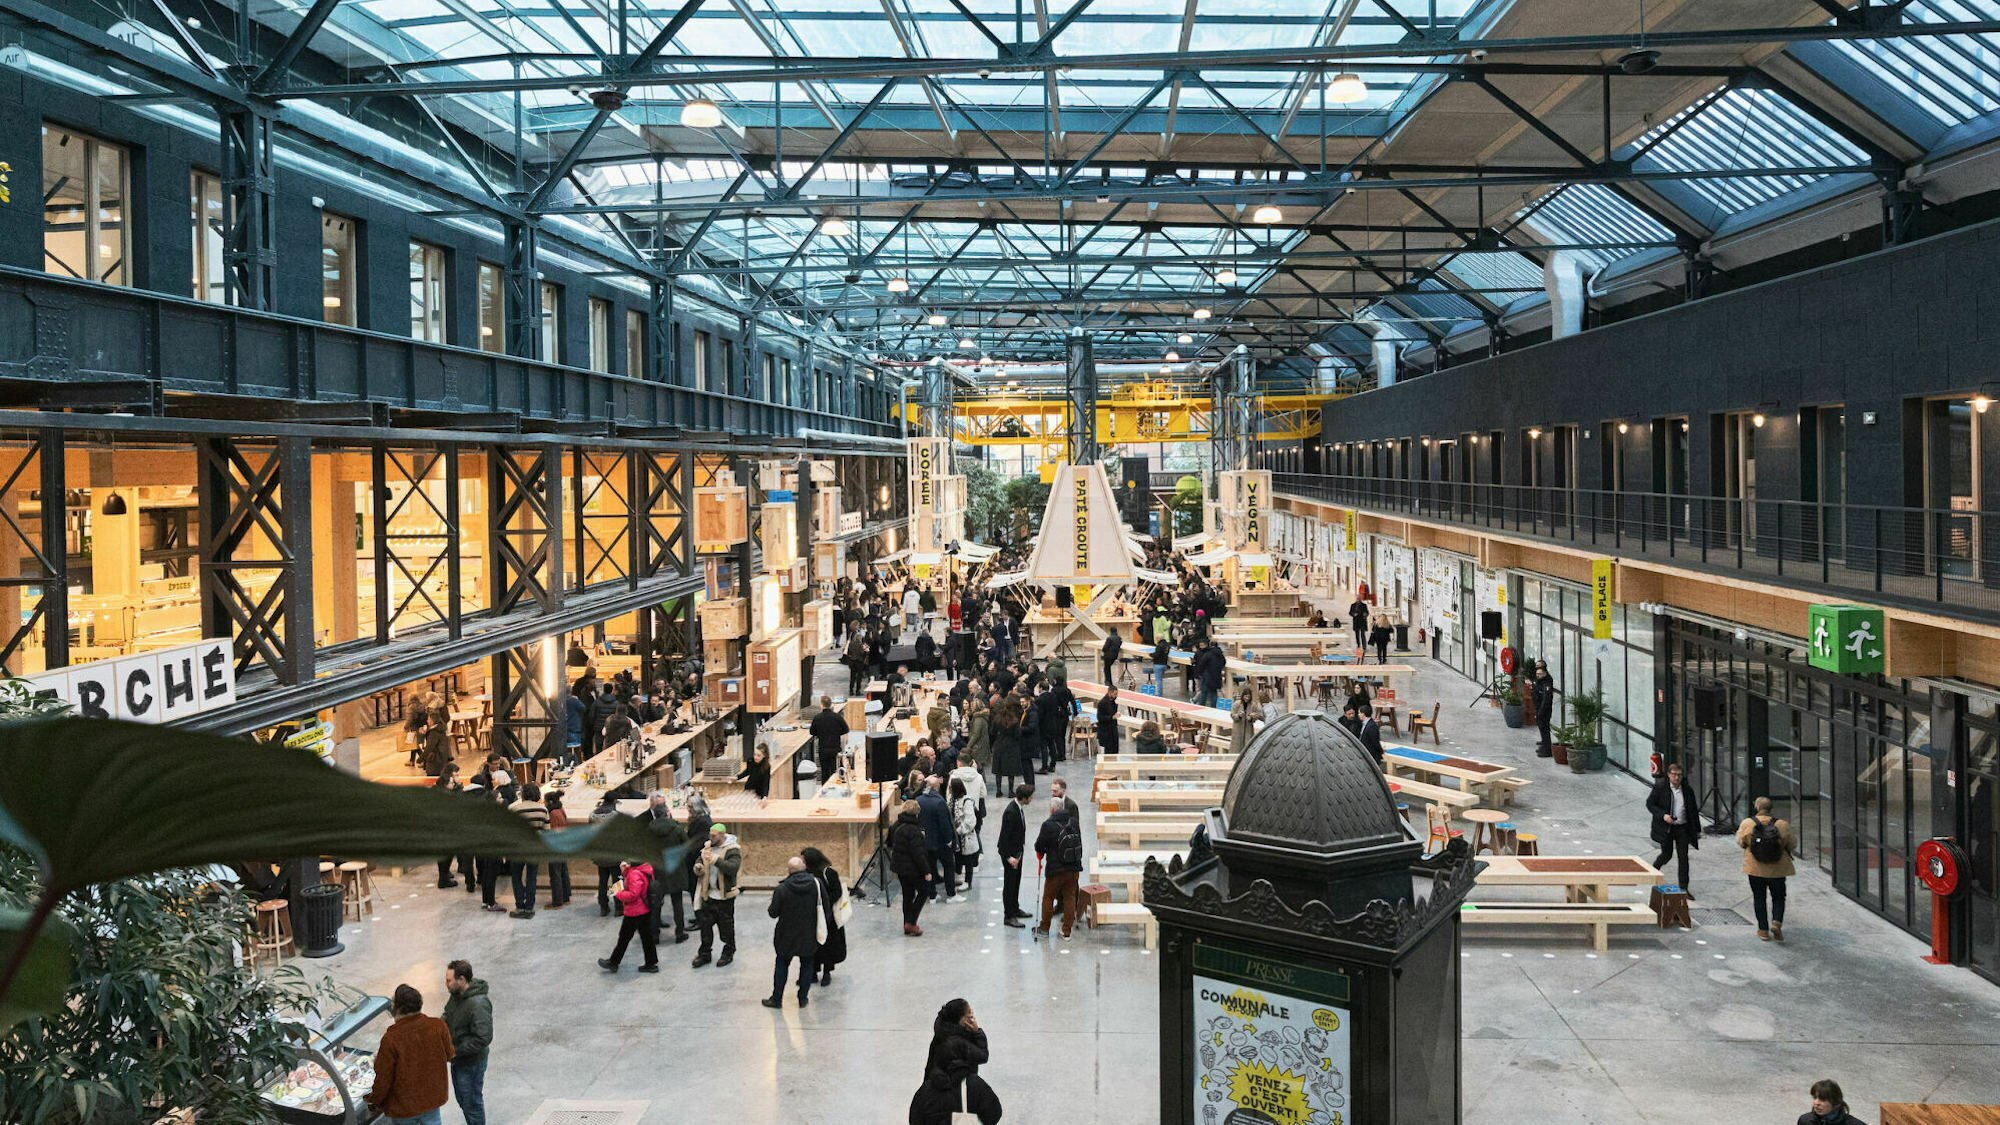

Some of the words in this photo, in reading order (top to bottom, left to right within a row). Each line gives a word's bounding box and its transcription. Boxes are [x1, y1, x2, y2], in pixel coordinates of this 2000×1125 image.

[920, 448, 931, 505] CORÉE
[1247, 483, 1259, 542] VÉGAN
[1598, 575, 1607, 608] PLACE
[1246, 959, 1297, 984] PRESSE
[1201, 988, 1290, 1020] COMMUNALE
[1245, 1073, 1292, 1094] VENEZ
[1250, 1086, 1288, 1106] C'EST
